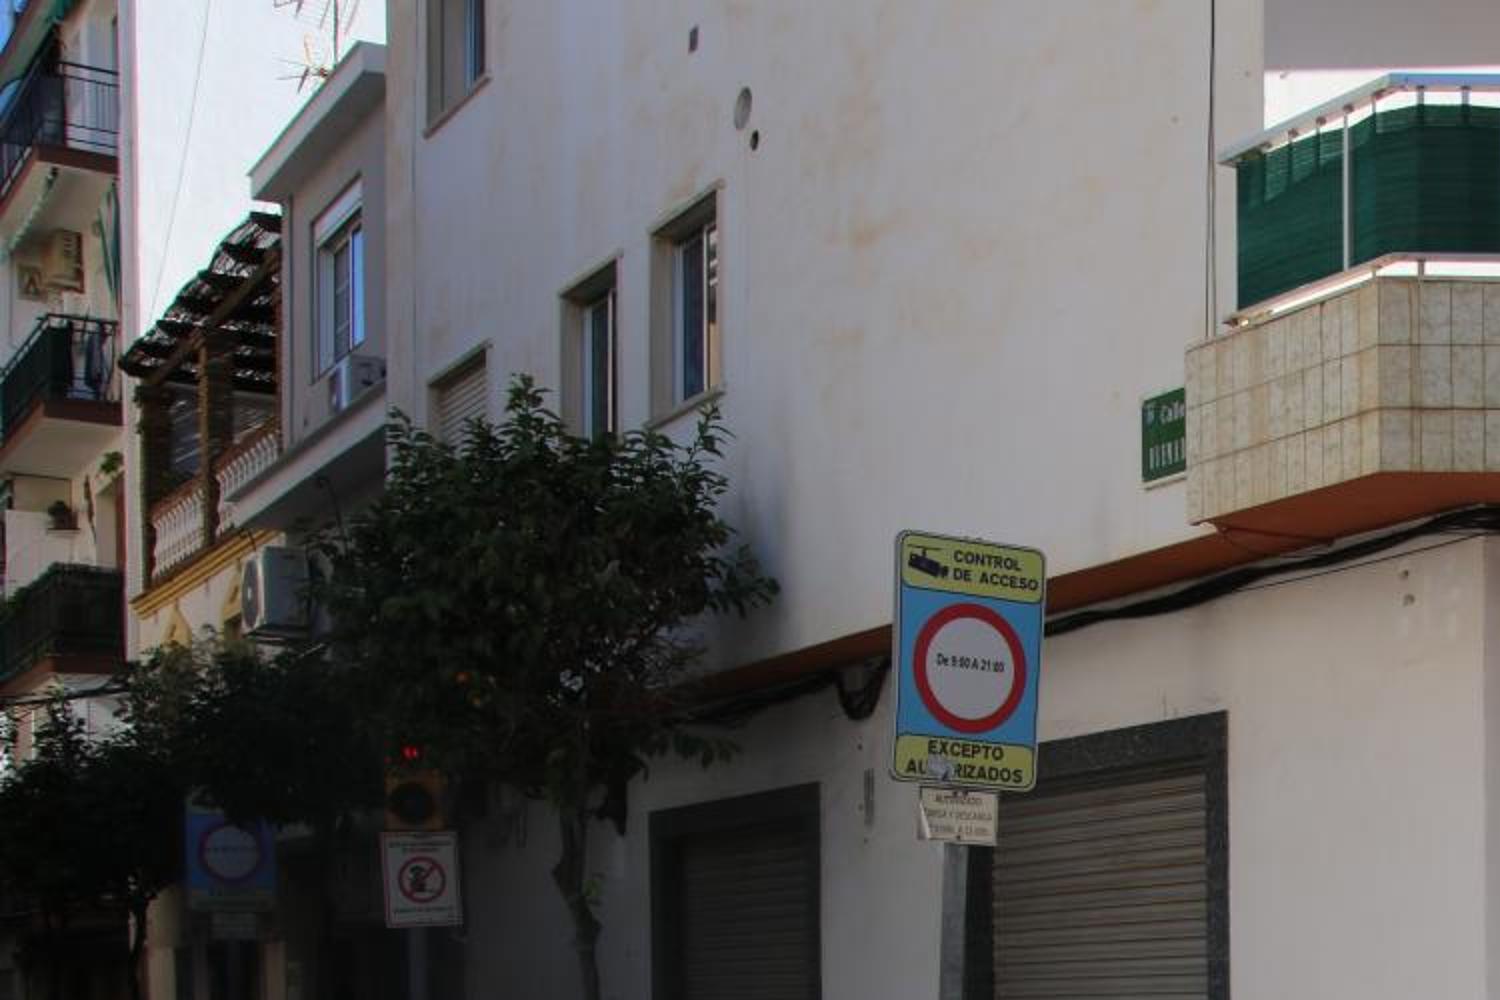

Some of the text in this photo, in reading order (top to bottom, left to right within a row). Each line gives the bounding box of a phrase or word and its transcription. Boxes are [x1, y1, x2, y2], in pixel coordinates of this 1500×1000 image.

[953, 549, 1022, 571] CONTROL
[953, 567, 1039, 591] DE ACCESO
[936, 653, 949, 666] De
[928, 740, 1004, 761] EXCEPTO
[905, 758, 1024, 783] AURIZADOS
